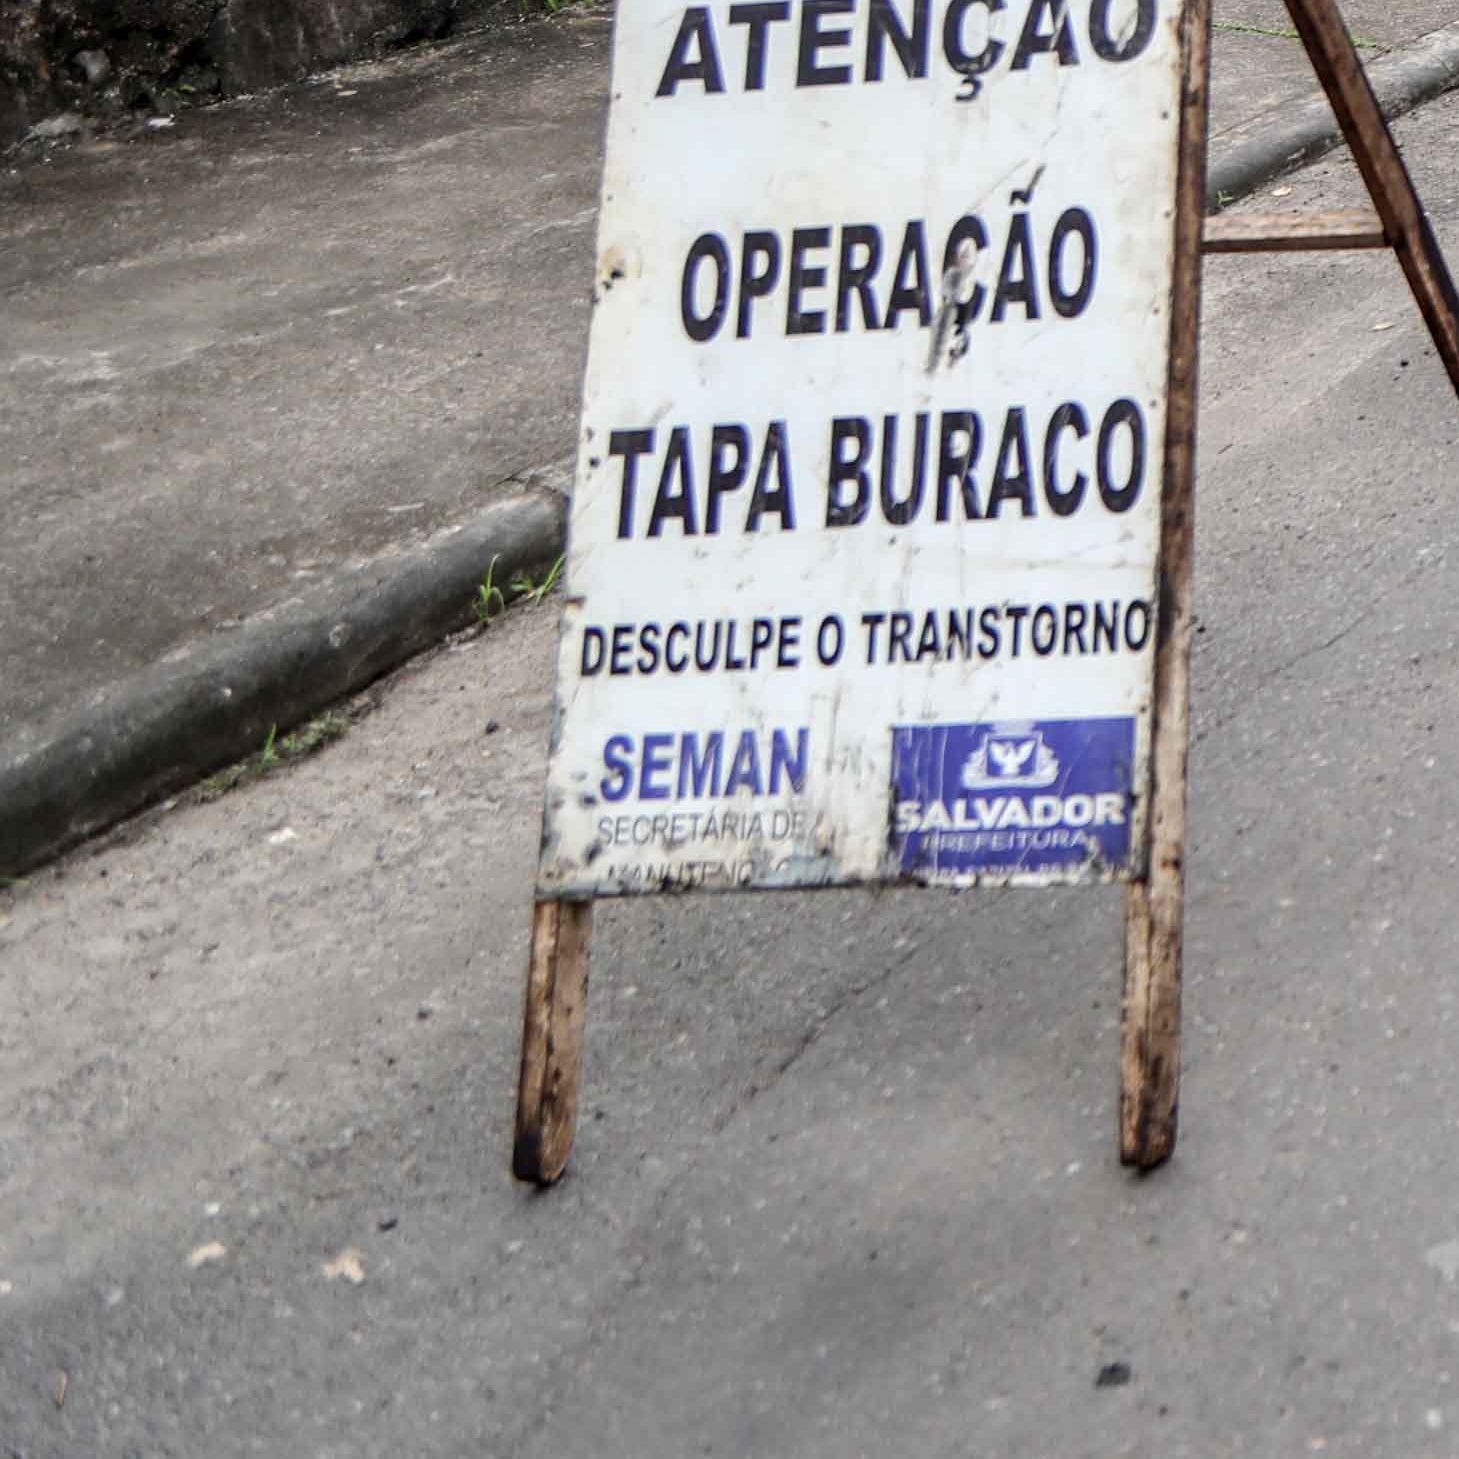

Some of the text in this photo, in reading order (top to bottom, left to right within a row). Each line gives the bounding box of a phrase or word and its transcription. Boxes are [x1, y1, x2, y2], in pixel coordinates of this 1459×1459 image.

[680, 167, 1099, 367] OPERAÇÃO
[608, 398, 1148, 540] TAPA BURACO
[579, 599, 1154, 678] DESCULPE O TRANSTORNO
[600, 727, 811, 803] SEMAN
[896, 793, 1126, 833] SALVADOR
